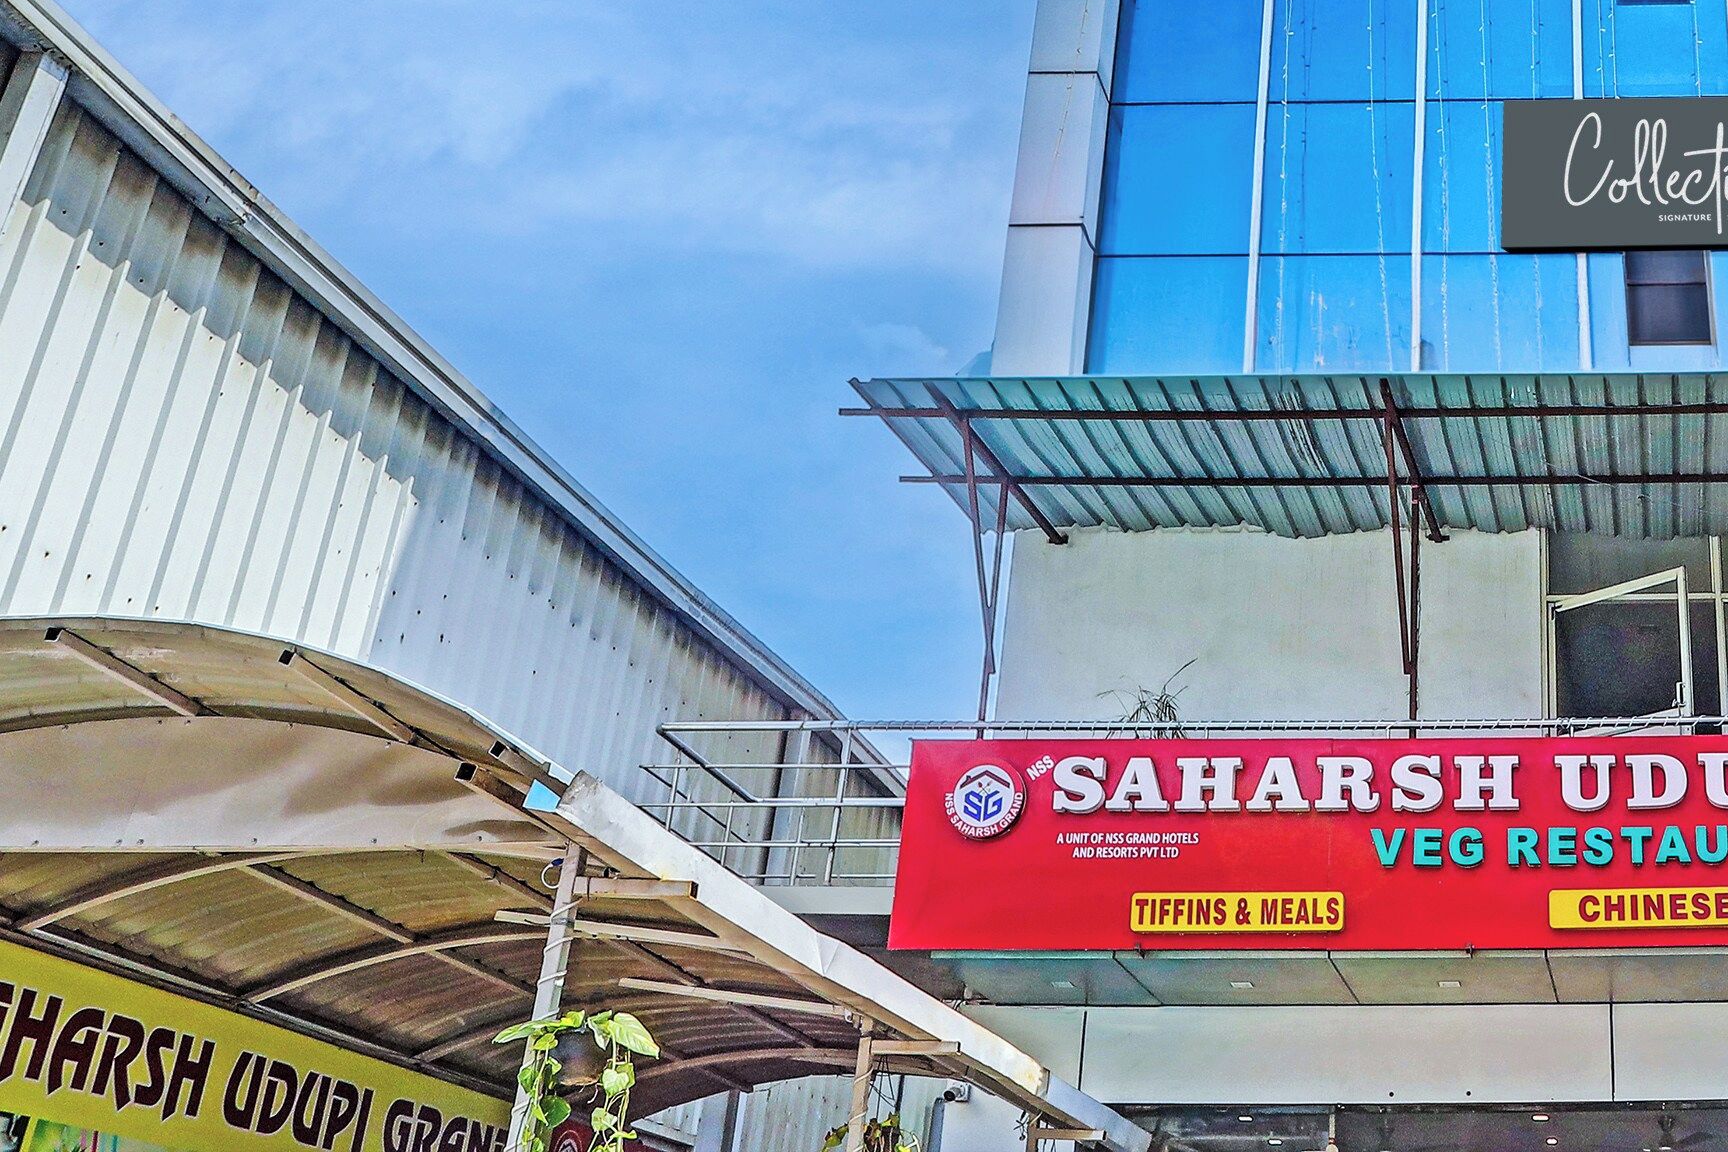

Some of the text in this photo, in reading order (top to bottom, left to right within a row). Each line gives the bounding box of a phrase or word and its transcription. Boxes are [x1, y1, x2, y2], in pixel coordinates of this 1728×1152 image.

[1658, 213, 1712, 222] SIGNATURE
[1026, 755, 1055, 781] NSS
[1052, 754, 1521, 813] SAHARSH
[944, 792, 1023, 837] NSS SAHARSH GRAND
[1056, 833, 1199, 844] A UNIT OF NSS GRAND HOTELS
[1072, 847, 1179, 858] AND RESORTS PVT LTD
[1371, 827, 1485, 868] VEG
[1134, 896, 1340, 927] TIFFINS & MEALS
[0, 980, 507, 1152] HARSH UDUPI GRAN
